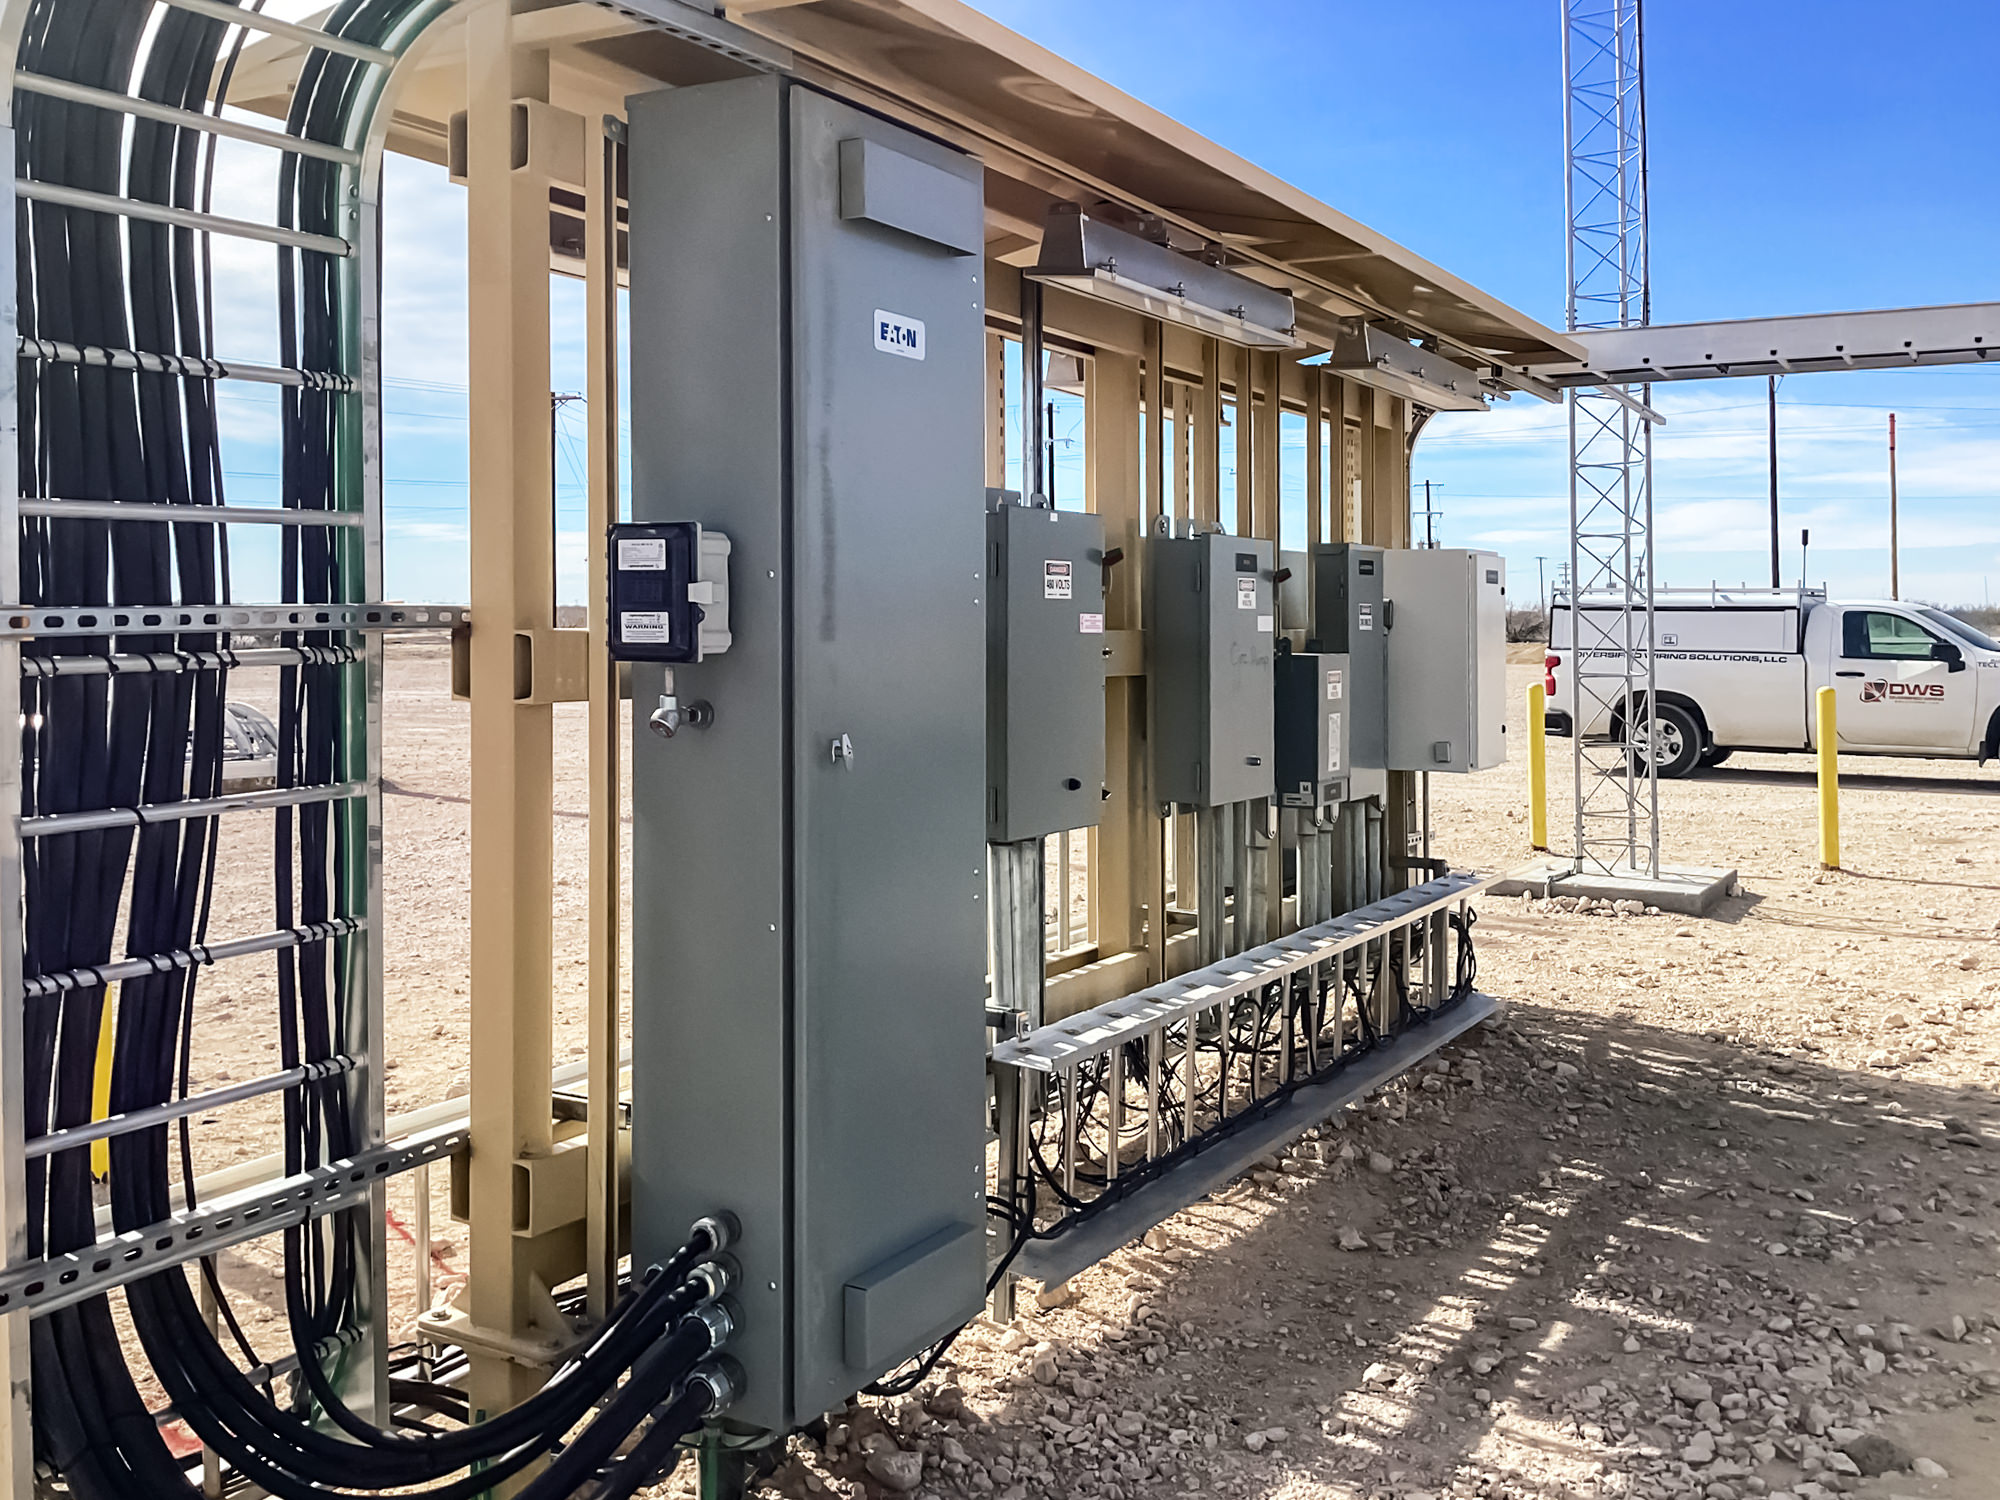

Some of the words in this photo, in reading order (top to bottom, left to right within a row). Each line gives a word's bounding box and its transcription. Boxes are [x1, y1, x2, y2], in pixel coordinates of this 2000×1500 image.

[1055, 579, 1070, 590] VOLTS
[1577, 651, 1642, 659] DIVERSIFD
[1689, 654, 1762, 663] SOLUTIONS,
[1889, 683, 1944, 696] DWS
